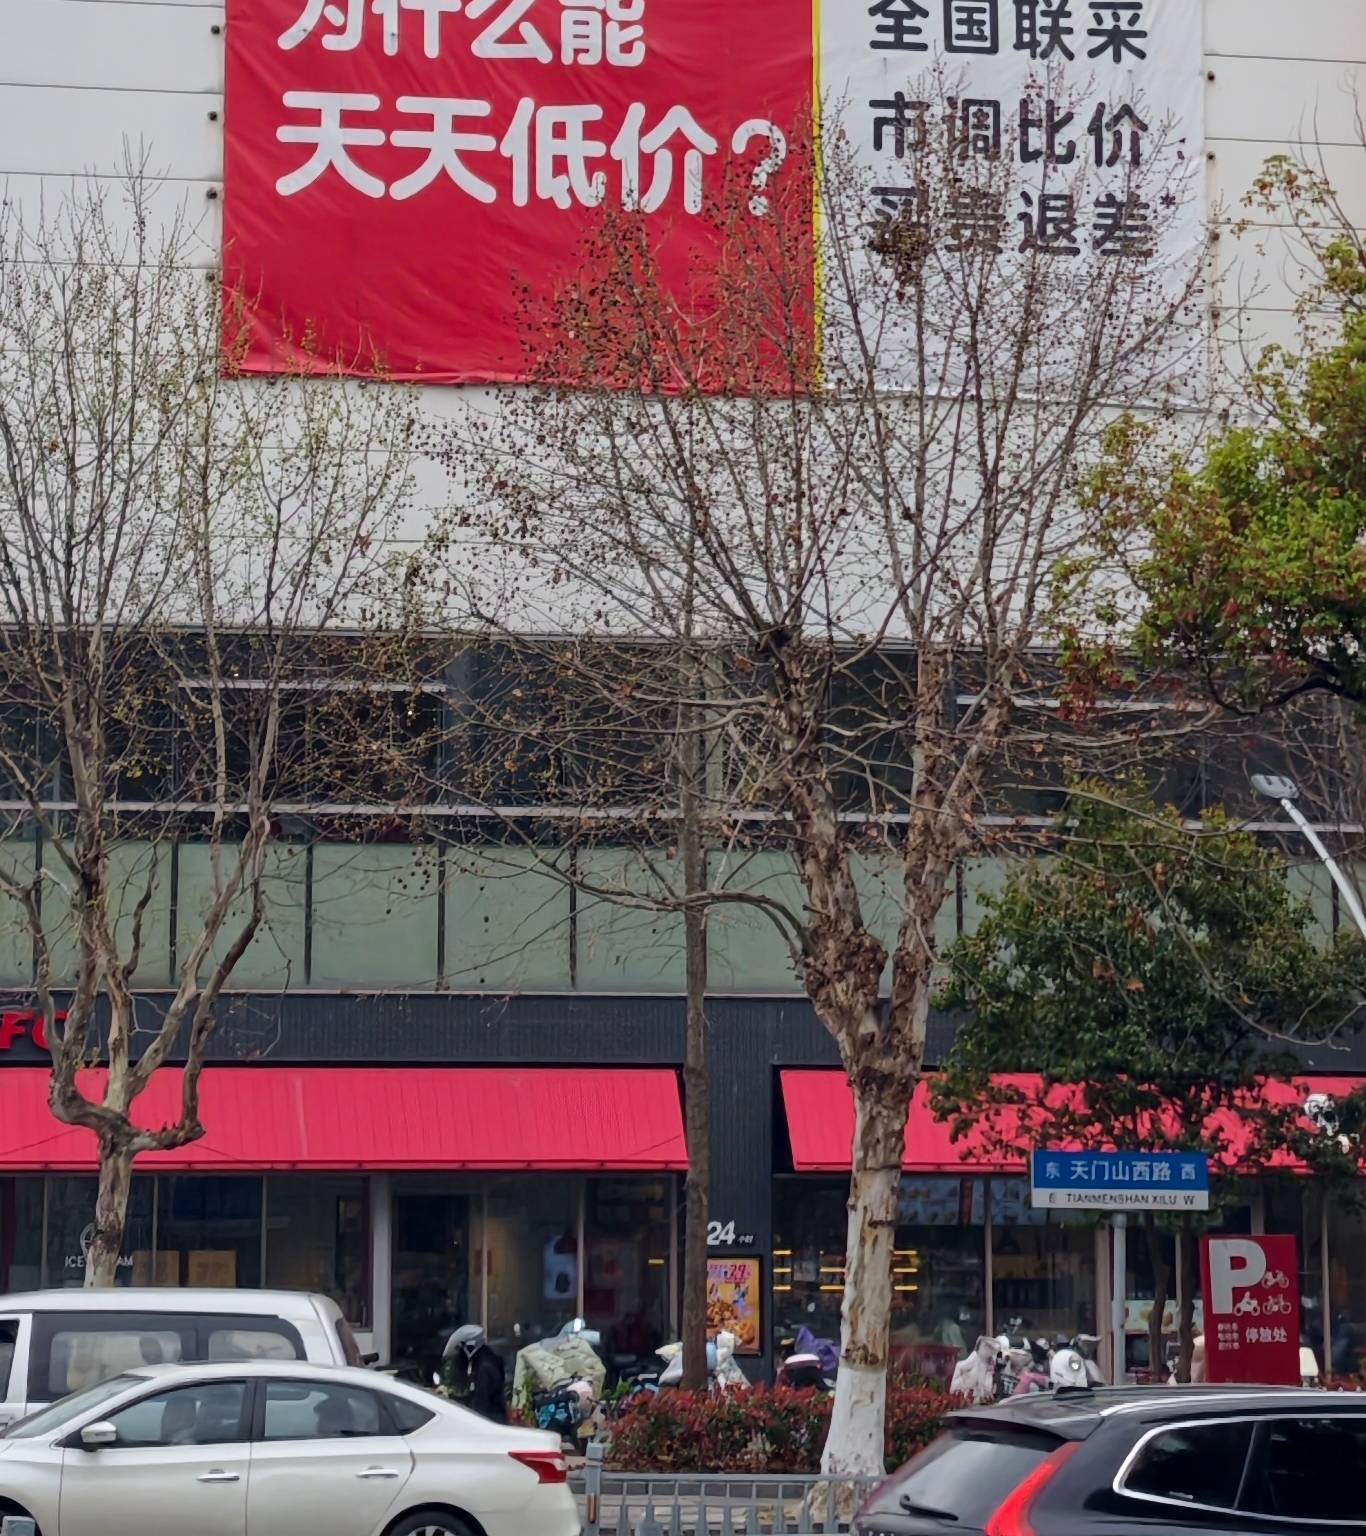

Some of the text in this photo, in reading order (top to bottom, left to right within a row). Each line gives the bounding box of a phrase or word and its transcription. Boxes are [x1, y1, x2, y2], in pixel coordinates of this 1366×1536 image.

[868, 91, 1149, 168] 市调比价
[1070, 1160, 1171, 1181] 天门山西路
[1180, 1162, 1196, 1180] 西
[1184, 1194, 1195, 1205] W
[1208, 1238, 1267, 1314] P
